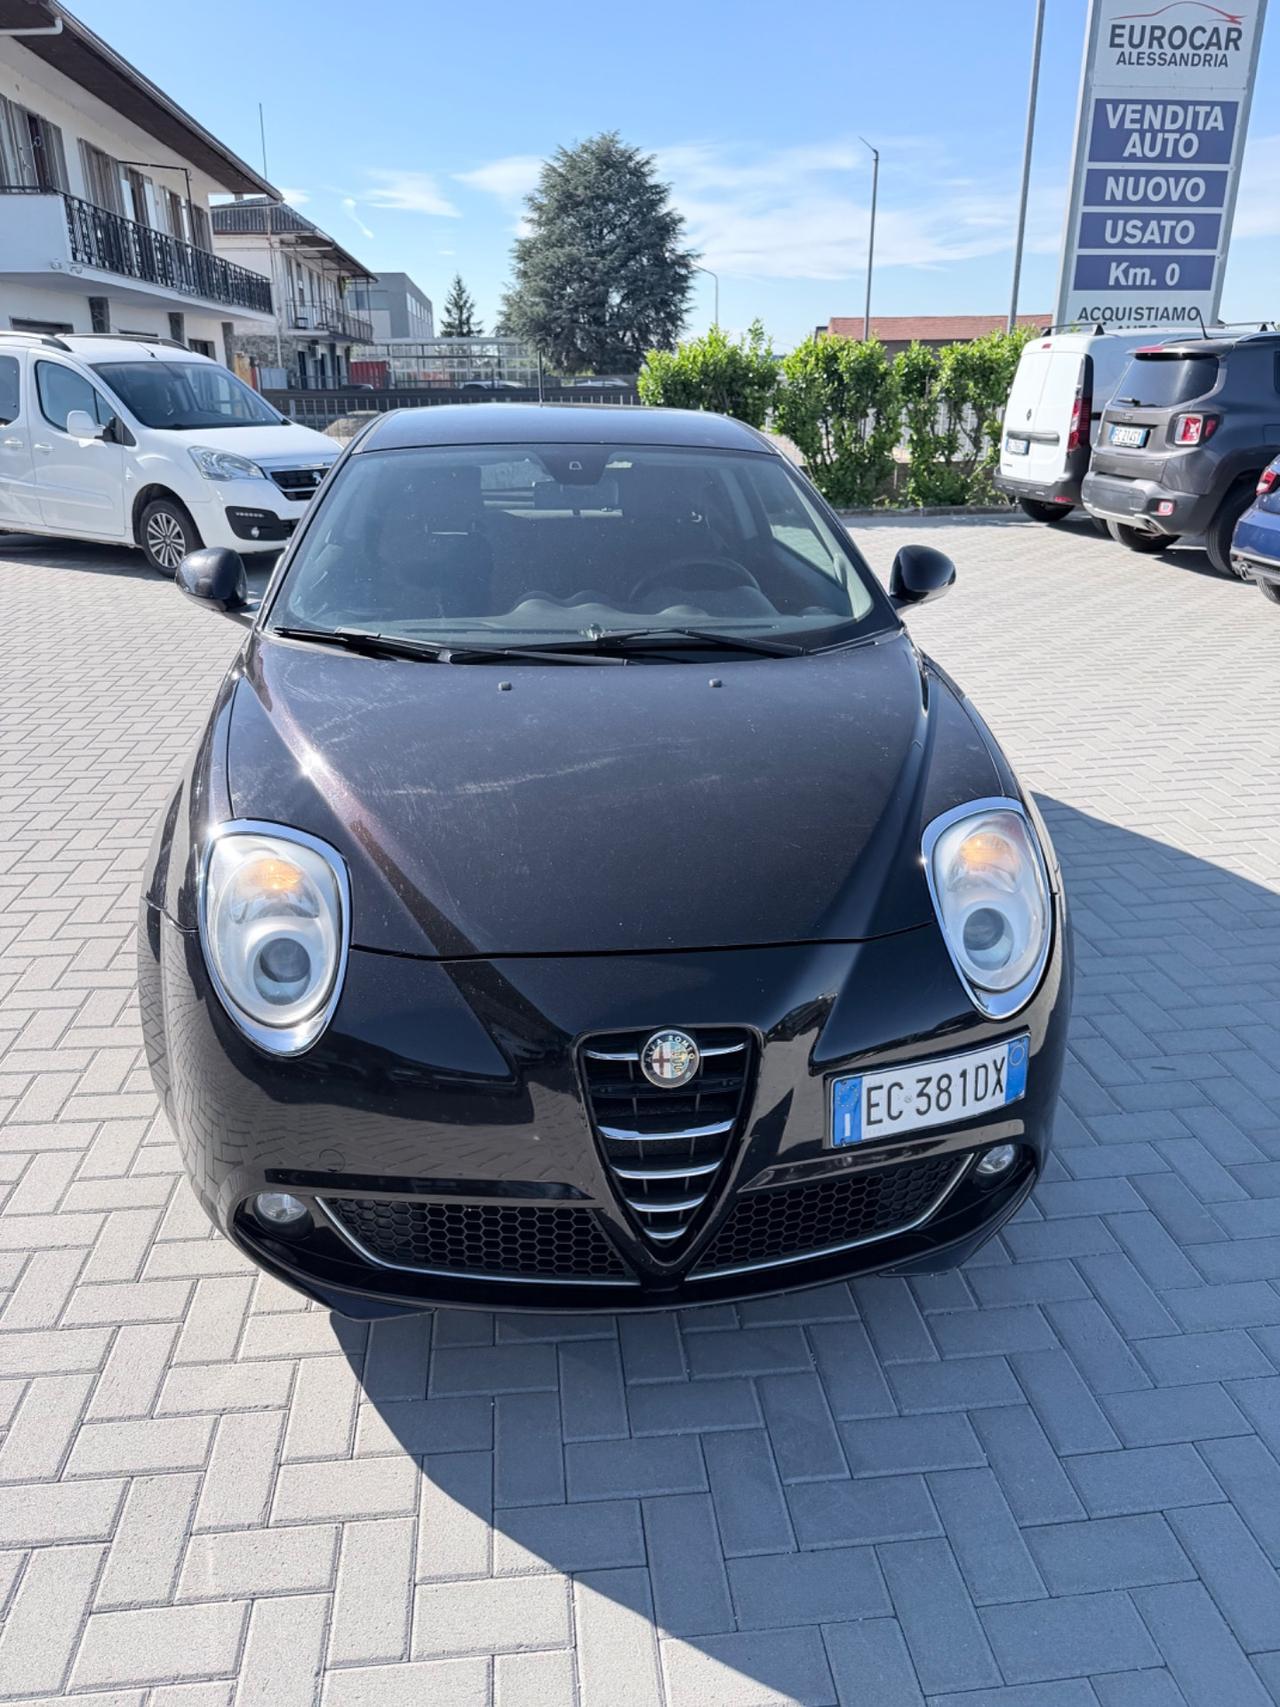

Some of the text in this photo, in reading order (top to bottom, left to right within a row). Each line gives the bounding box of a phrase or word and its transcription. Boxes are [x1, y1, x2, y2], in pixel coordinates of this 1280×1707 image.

[1109, 24, 1243, 51] EUROCAR
[1115, 51, 1229, 68] ALESSANDRIA
[1106, 104, 1224, 131] VENDITA
[1122, 132, 1199, 159] AUTO
[1105, 176, 1206, 202] NUOVO
[1105, 219, 1195, 245] USATO
[1108, 262, 1180, 287] Km. 0
[1077, 306, 1201, 322] ACQUISTIAMO
[866, 1056, 1006, 1127] EC 381DX
